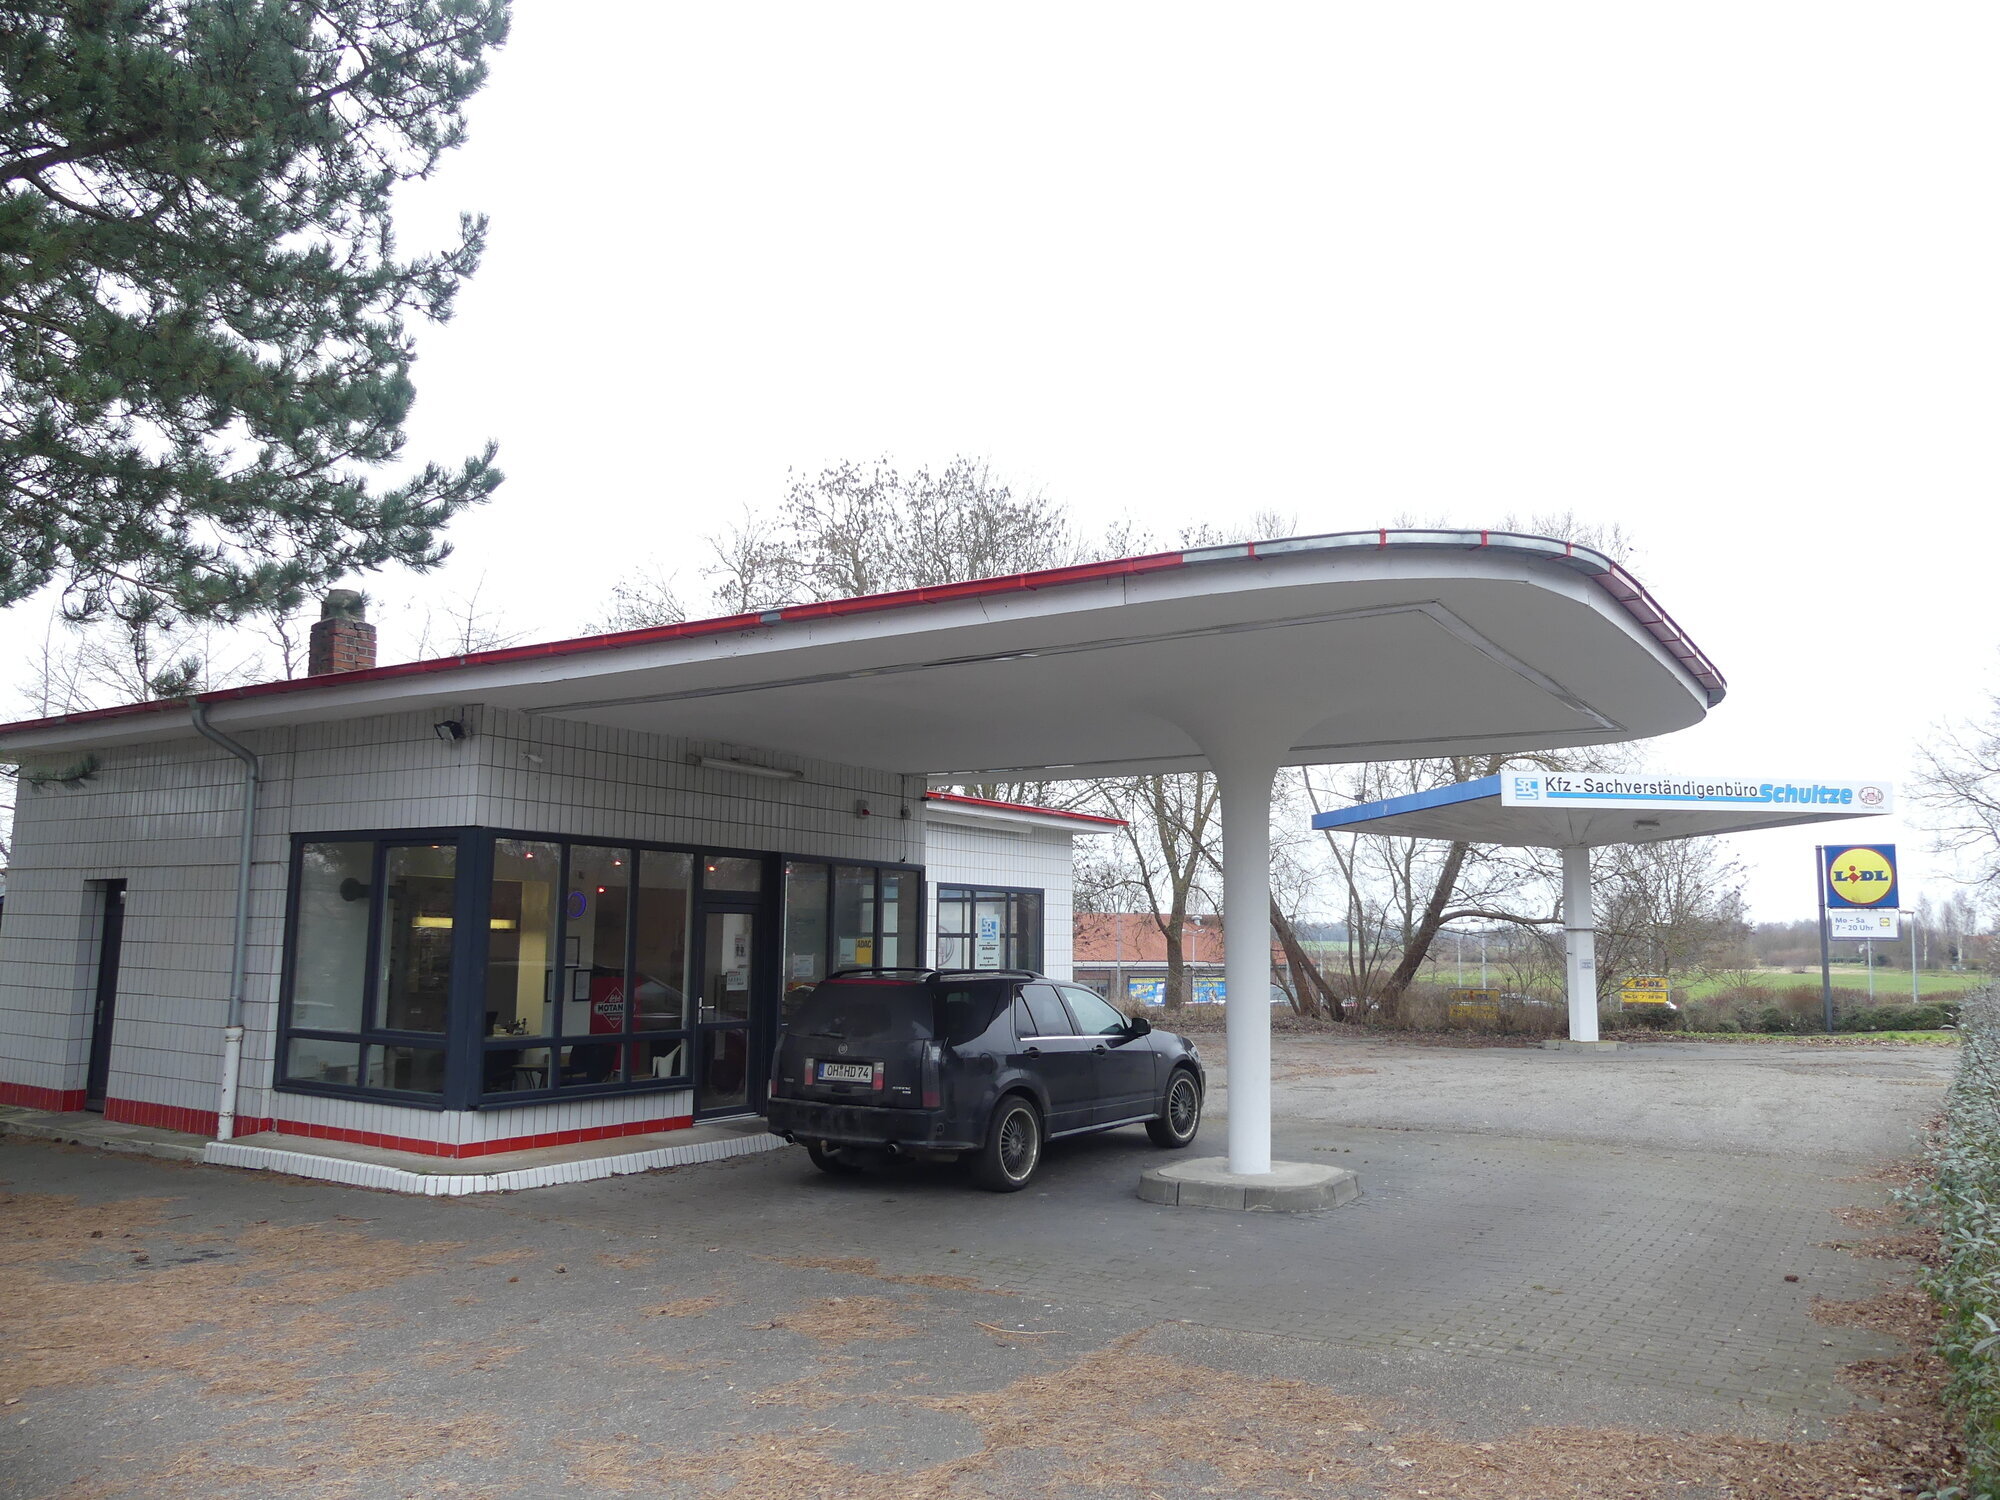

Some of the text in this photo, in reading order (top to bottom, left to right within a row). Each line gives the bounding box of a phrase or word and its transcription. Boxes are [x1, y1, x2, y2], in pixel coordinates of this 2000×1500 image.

[1759, 784, 1853, 804] Schultze
[1834, 865, 1888, 884] LIDL
[857, 940, 871, 948] ADAC
[827, 1066, 870, 1078] OH HD 74
